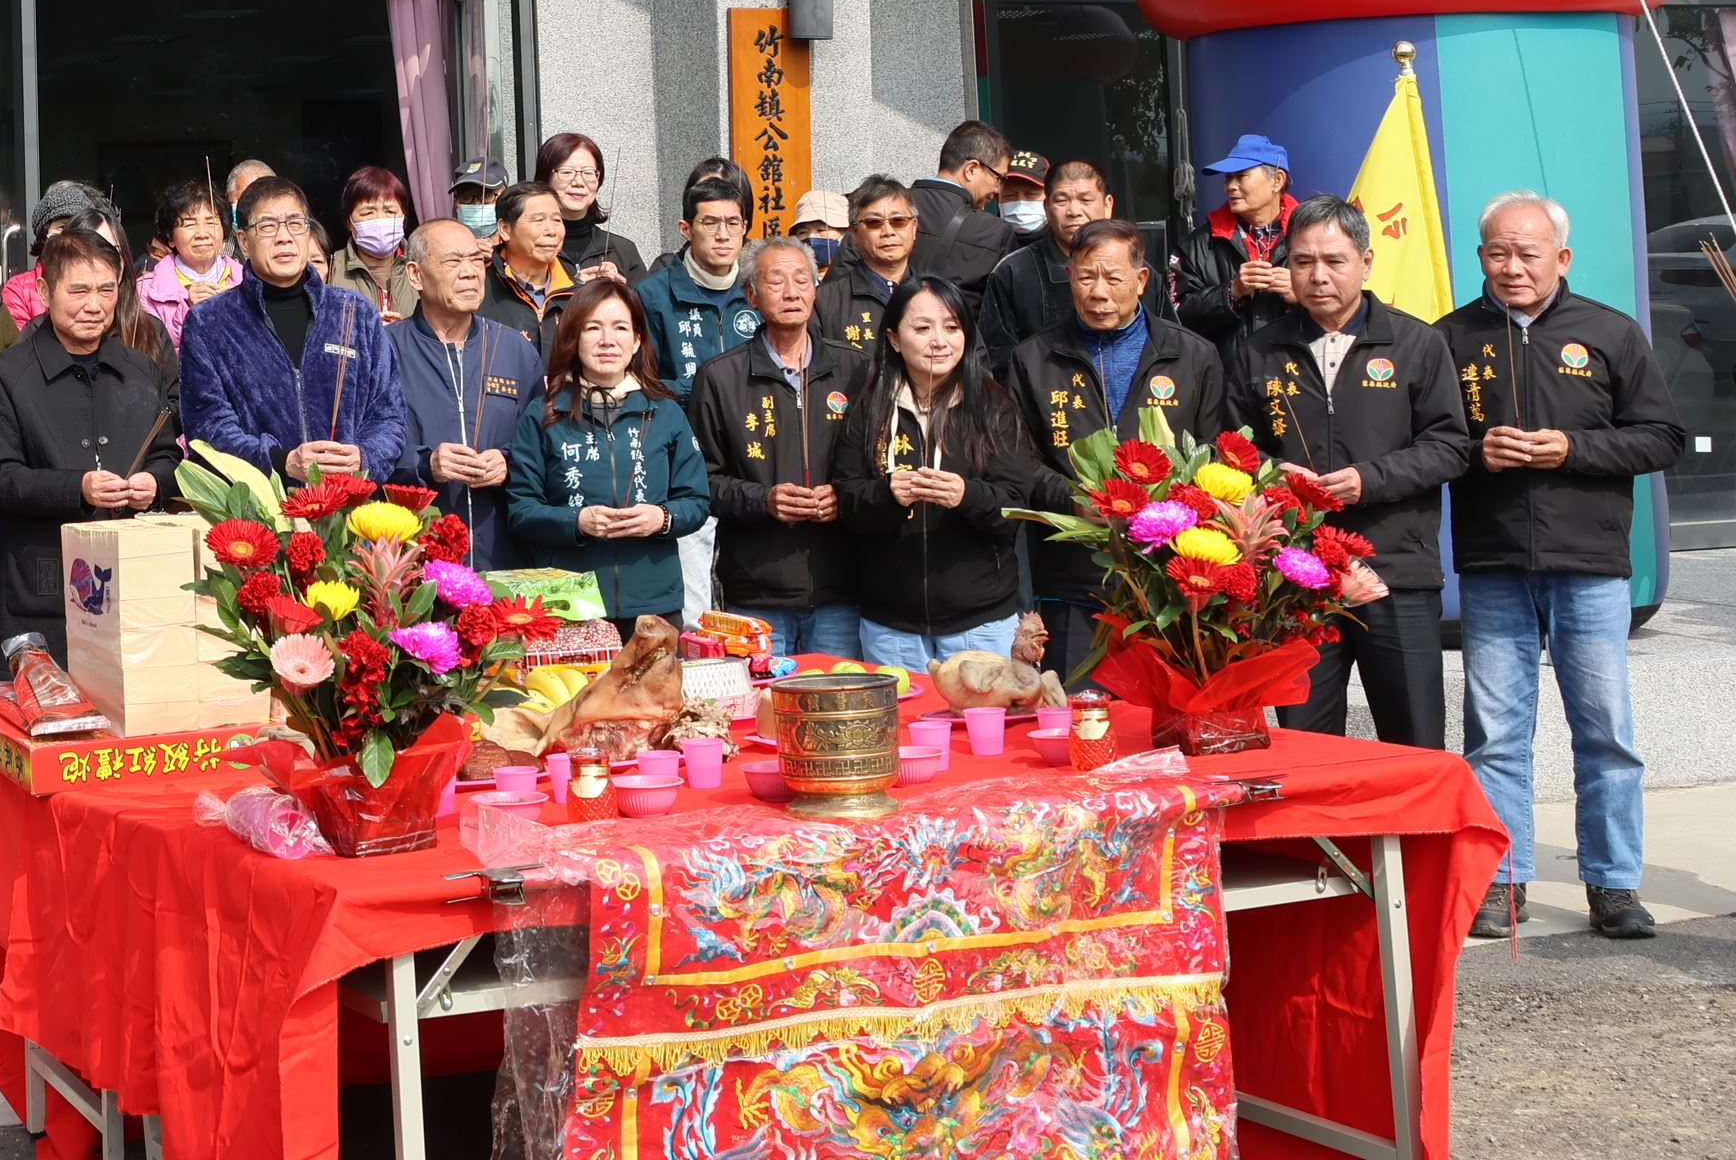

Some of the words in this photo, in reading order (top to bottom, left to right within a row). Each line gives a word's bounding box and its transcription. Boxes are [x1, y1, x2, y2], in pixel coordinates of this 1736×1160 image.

[754, 24, 789, 239] 竹南鎮公館社區
[688, 307, 703, 338] 議員
[861, 311, 875, 340] 里長
[1284, 361, 1301, 396] 代表
[1482, 343, 1497, 380] 代表
[1072, 373, 1086, 410] 代表
[761, 396, 776, 438] 副主席
[1050, 390, 1070, 447] 邱進旺
[585, 432, 600, 462] 主席
[745, 412, 765, 460] 李城
[627, 427, 648, 503] 竹南鎮民代表
